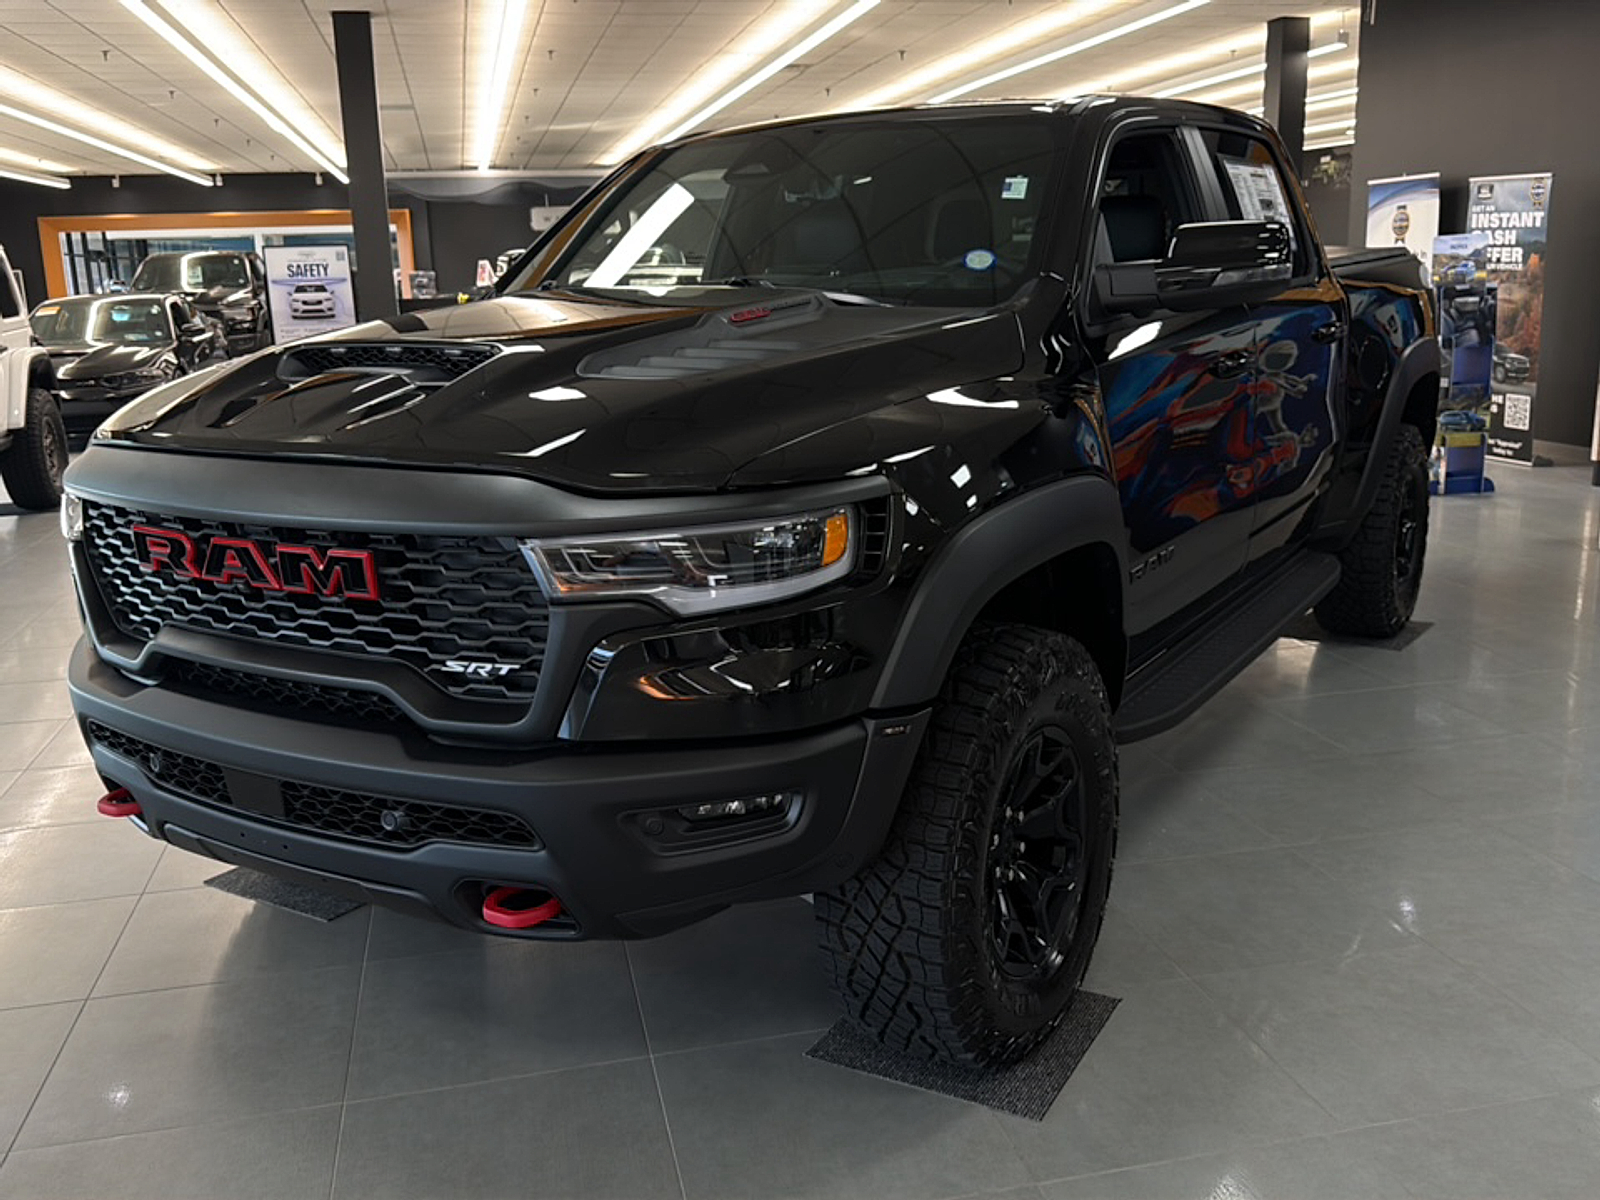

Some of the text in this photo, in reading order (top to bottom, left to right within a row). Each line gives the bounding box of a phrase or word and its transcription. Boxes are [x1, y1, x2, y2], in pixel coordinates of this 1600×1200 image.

[1471, 212, 1545, 228] INSTANT
[1471, 229, 1517, 245] ASH
[286, 263, 329, 278] SAFETY
[131, 523, 379, 600] RAM
[1129, 545, 1175, 585] RAM
[440, 660, 521, 677] SRT
